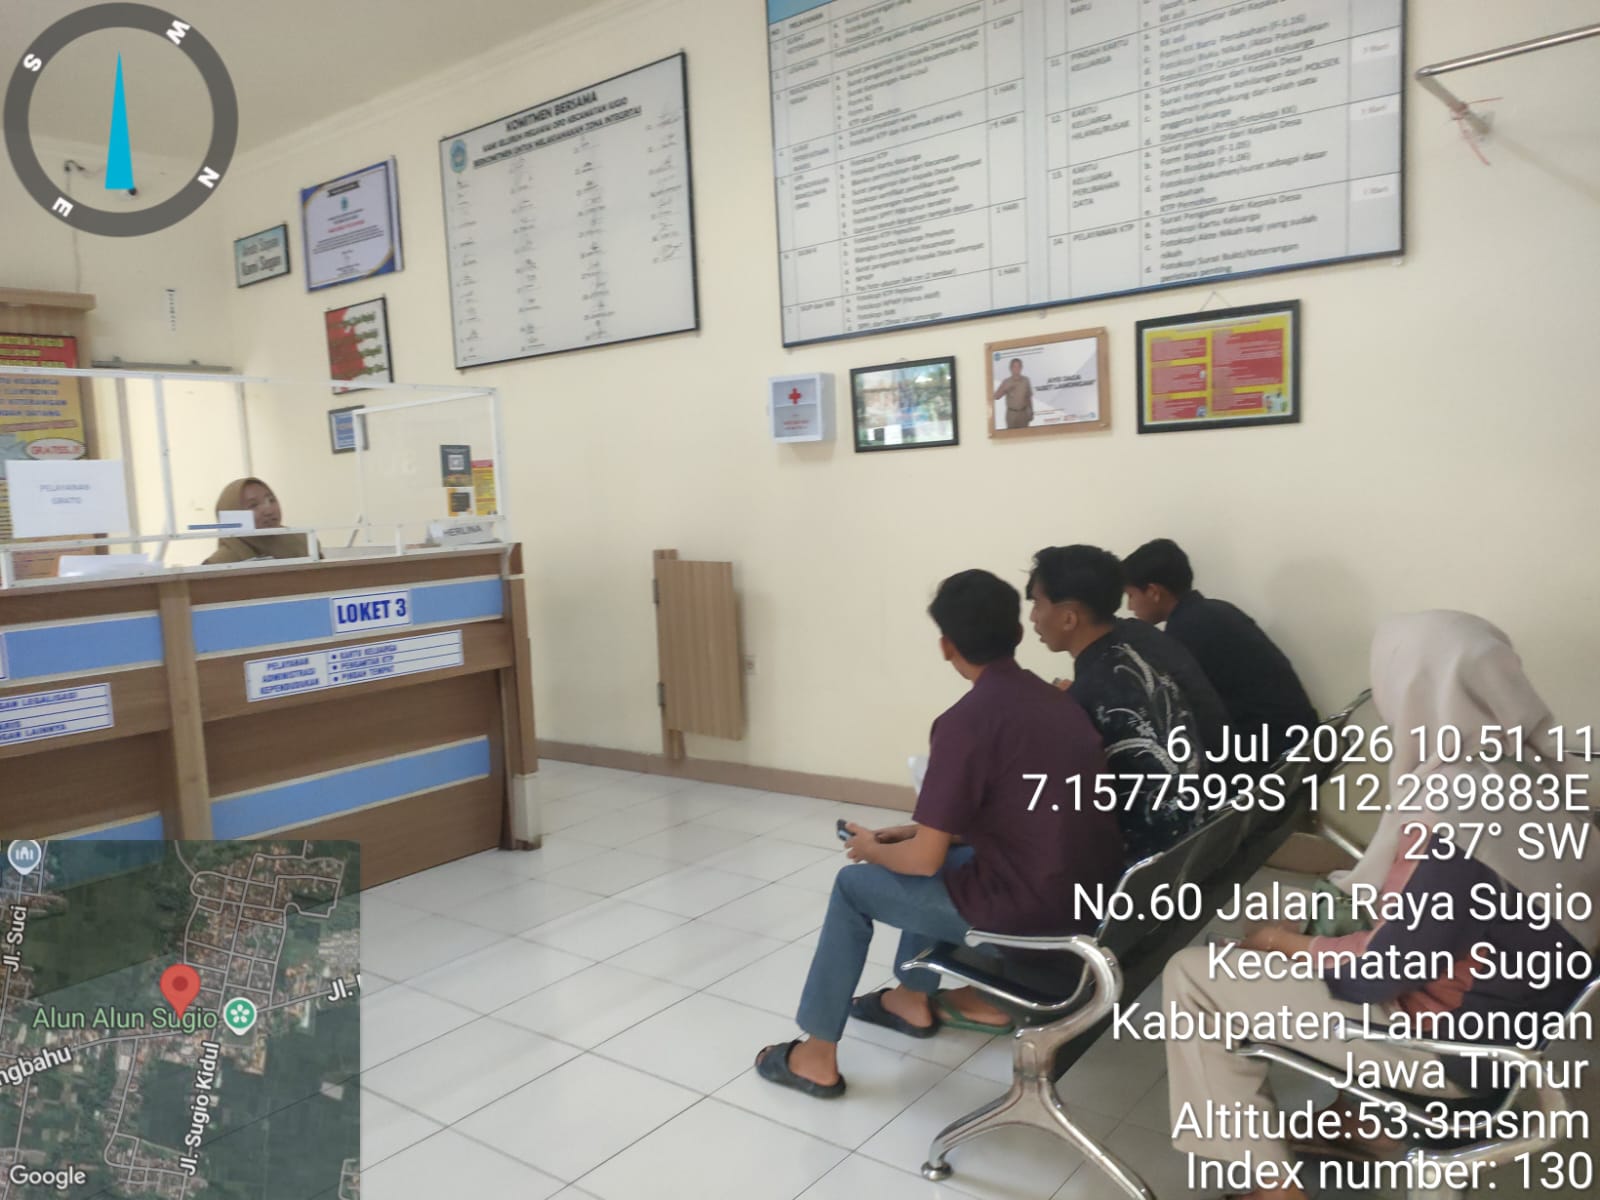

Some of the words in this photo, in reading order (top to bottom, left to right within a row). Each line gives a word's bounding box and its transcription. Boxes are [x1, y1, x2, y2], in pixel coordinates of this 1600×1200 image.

[337, 599, 391, 625] LOKET
[396, 598, 407, 617] 3
[267, 658, 309, 671] PELAYANAN
